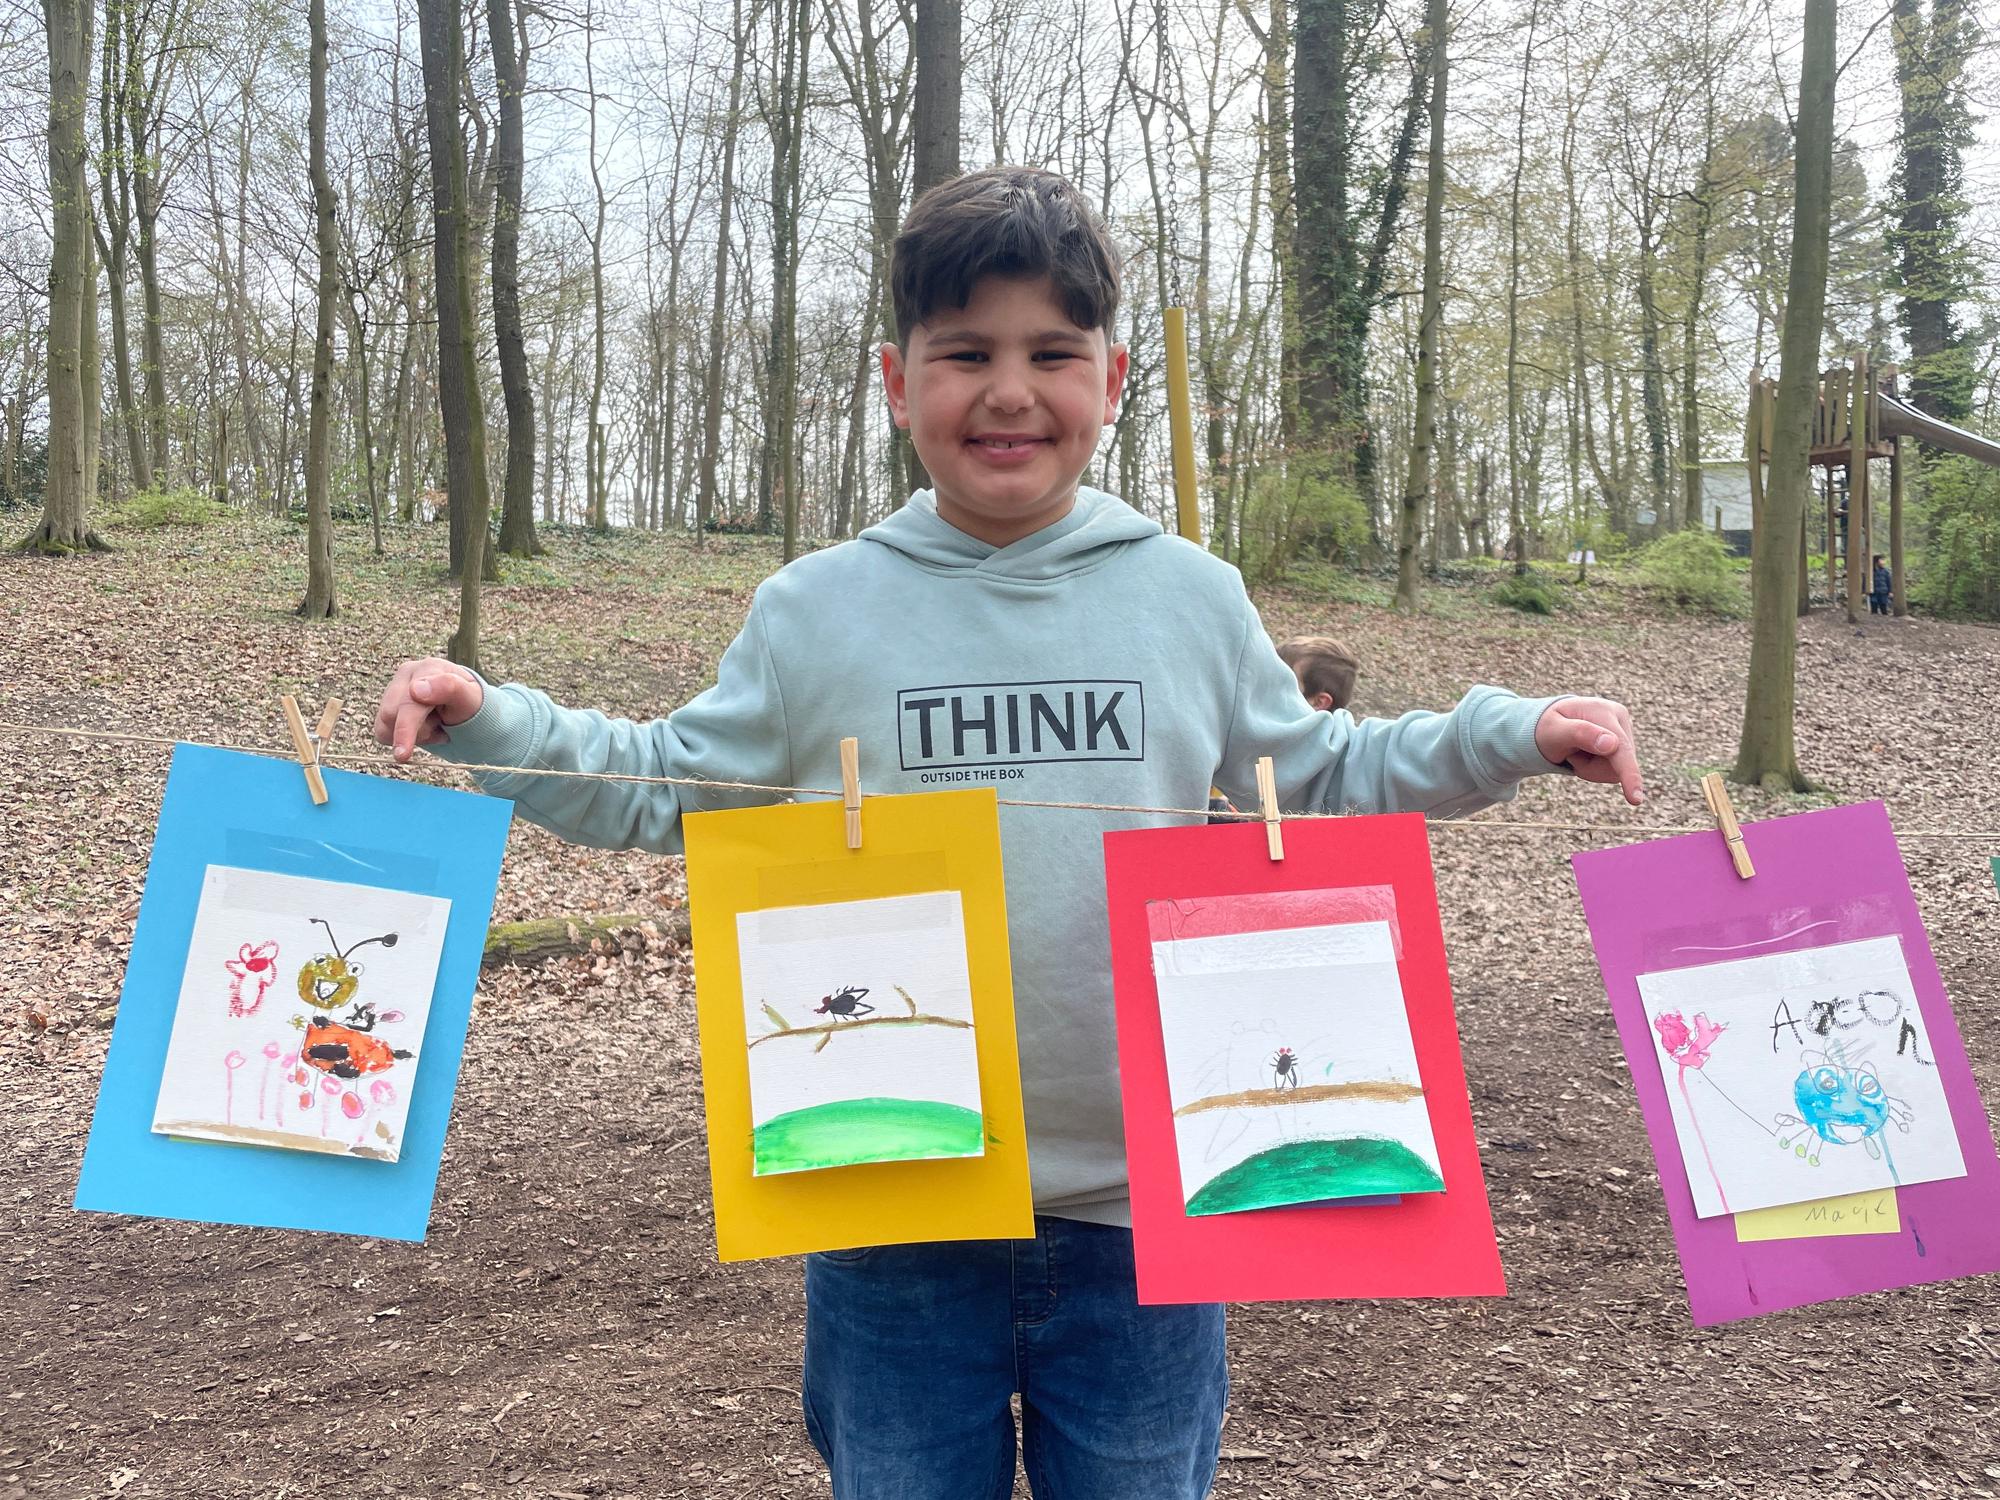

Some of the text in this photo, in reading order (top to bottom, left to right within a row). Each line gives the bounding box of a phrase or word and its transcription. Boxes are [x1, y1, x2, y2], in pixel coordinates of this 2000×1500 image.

[904, 691, 1131, 758] THINK
[920, 768, 1025, 783] OUTSIDE THE BOX
